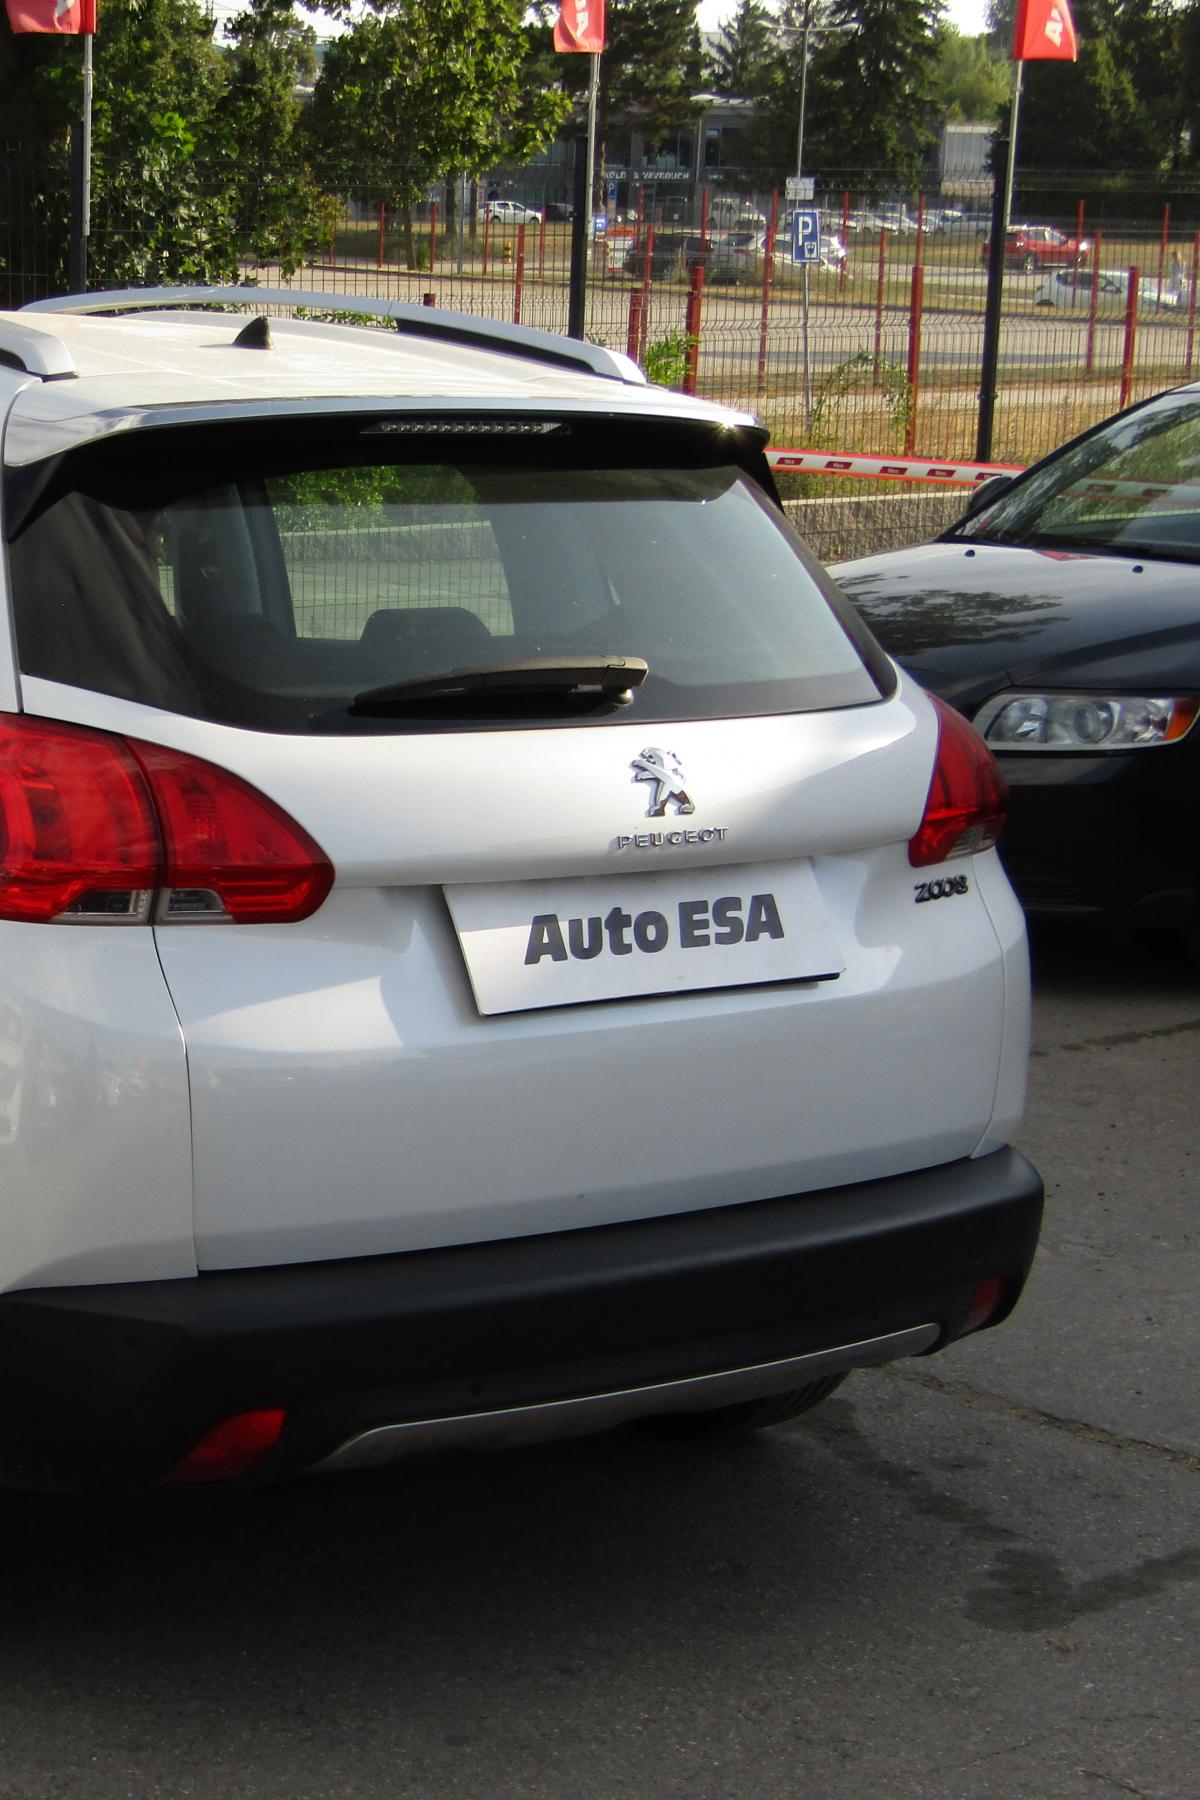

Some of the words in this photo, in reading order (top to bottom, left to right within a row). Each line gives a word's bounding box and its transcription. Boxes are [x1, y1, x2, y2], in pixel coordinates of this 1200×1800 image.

[798, 216, 812, 246] P
[618, 826, 729, 849] PEUGEOT
[914, 875, 968, 903] 2008
[524, 907, 669, 965] Auto
[678, 893, 785, 949] ESA
